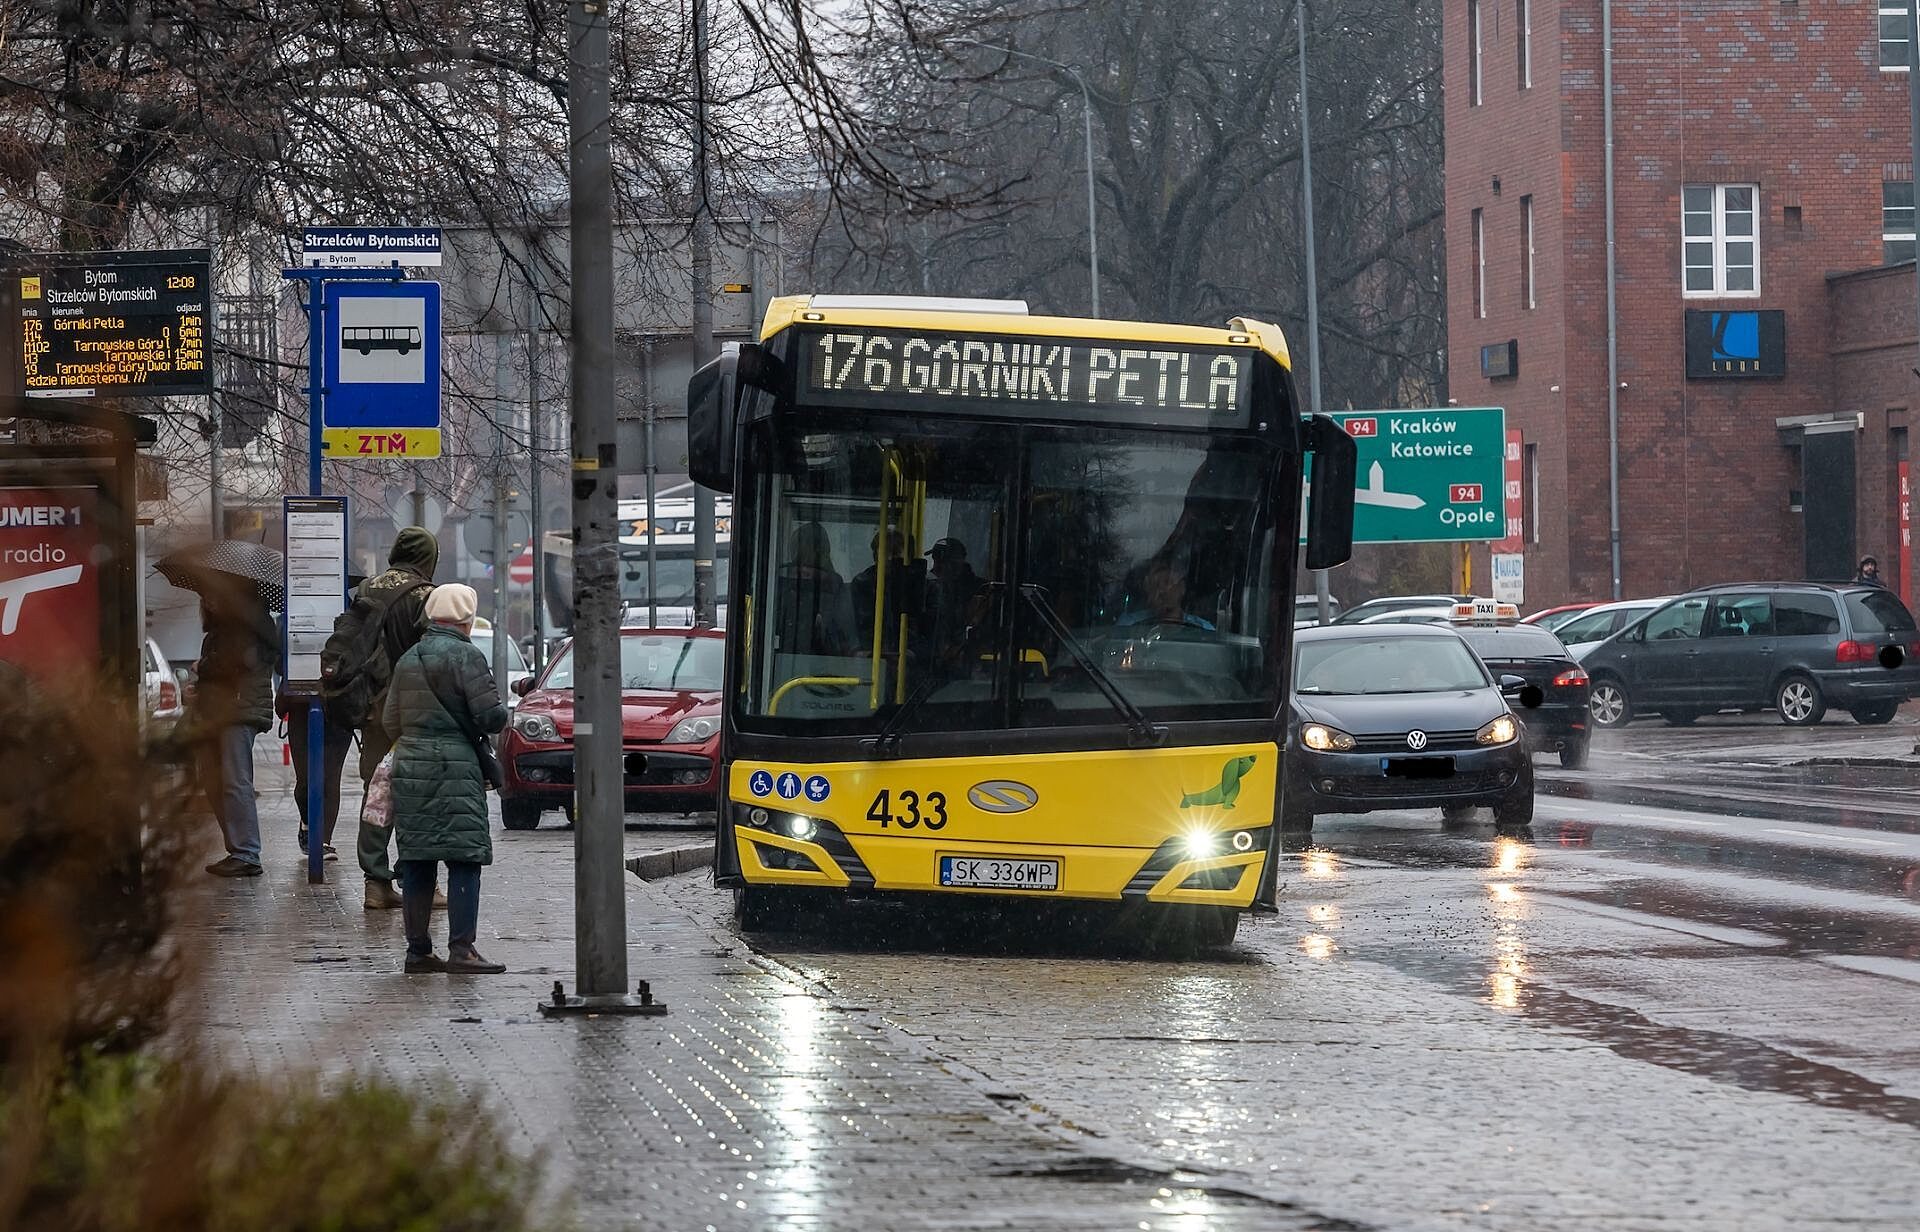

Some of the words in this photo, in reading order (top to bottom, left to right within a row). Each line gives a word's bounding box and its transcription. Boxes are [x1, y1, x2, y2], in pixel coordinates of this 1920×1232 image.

[305, 233, 365, 247] Strzelców
[368, 233, 439, 249] Bytomskich
[329, 254, 357, 265] Bytom
[84, 270, 118, 287] Bytom
[166, 276, 195, 289] 12:08
[47, 288, 97, 303] Strzelców
[99, 286, 157, 304] Bytomskich
[22, 308, 37, 317] linia
[51, 306, 84, 316] kierunek
[176, 303, 202, 314] odjazd
[23, 320, 42, 331] 176
[53, 318, 92, 331] Górniki
[180, 315, 202, 326] 1min
[23, 331, 42, 341] 114
[179, 326, 202, 337] 6min
[23, 341, 50, 353] M102
[73, 339, 134, 352] Tarnowskie
[138, 338, 164, 350] Góry
[179, 337, 202, 348] 7min
[24, 352, 38, 364] M3
[104, 349, 165, 361] Tarnowskie
[174, 348, 203, 360] 15min
[24, 364, 38, 375] 19
[55, 362, 116, 375] Tarnowskie
[118, 361, 144, 373] Góry
[175, 359, 203, 371] 16min
[820, 333, 893, 392] 176
[902, 338, 1071, 401] GÓRNIKI
[1352, 421, 1370, 434] 94
[1391, 417, 1456, 434] Kraków
[358, 435, 406, 453] ZTM
[1391, 441, 1473, 458] Katowice
[1457, 487, 1475, 500] 94
[70, 506, 81, 526] 1
[1439, 507, 1496, 528] Opole
[4, 543, 66, 563] radio
[1476, 604, 1494, 614] TAXI
[866, 789, 948, 831] 433
[956, 860, 981, 881] SK
[990, 862, 1051, 883] 336WP
